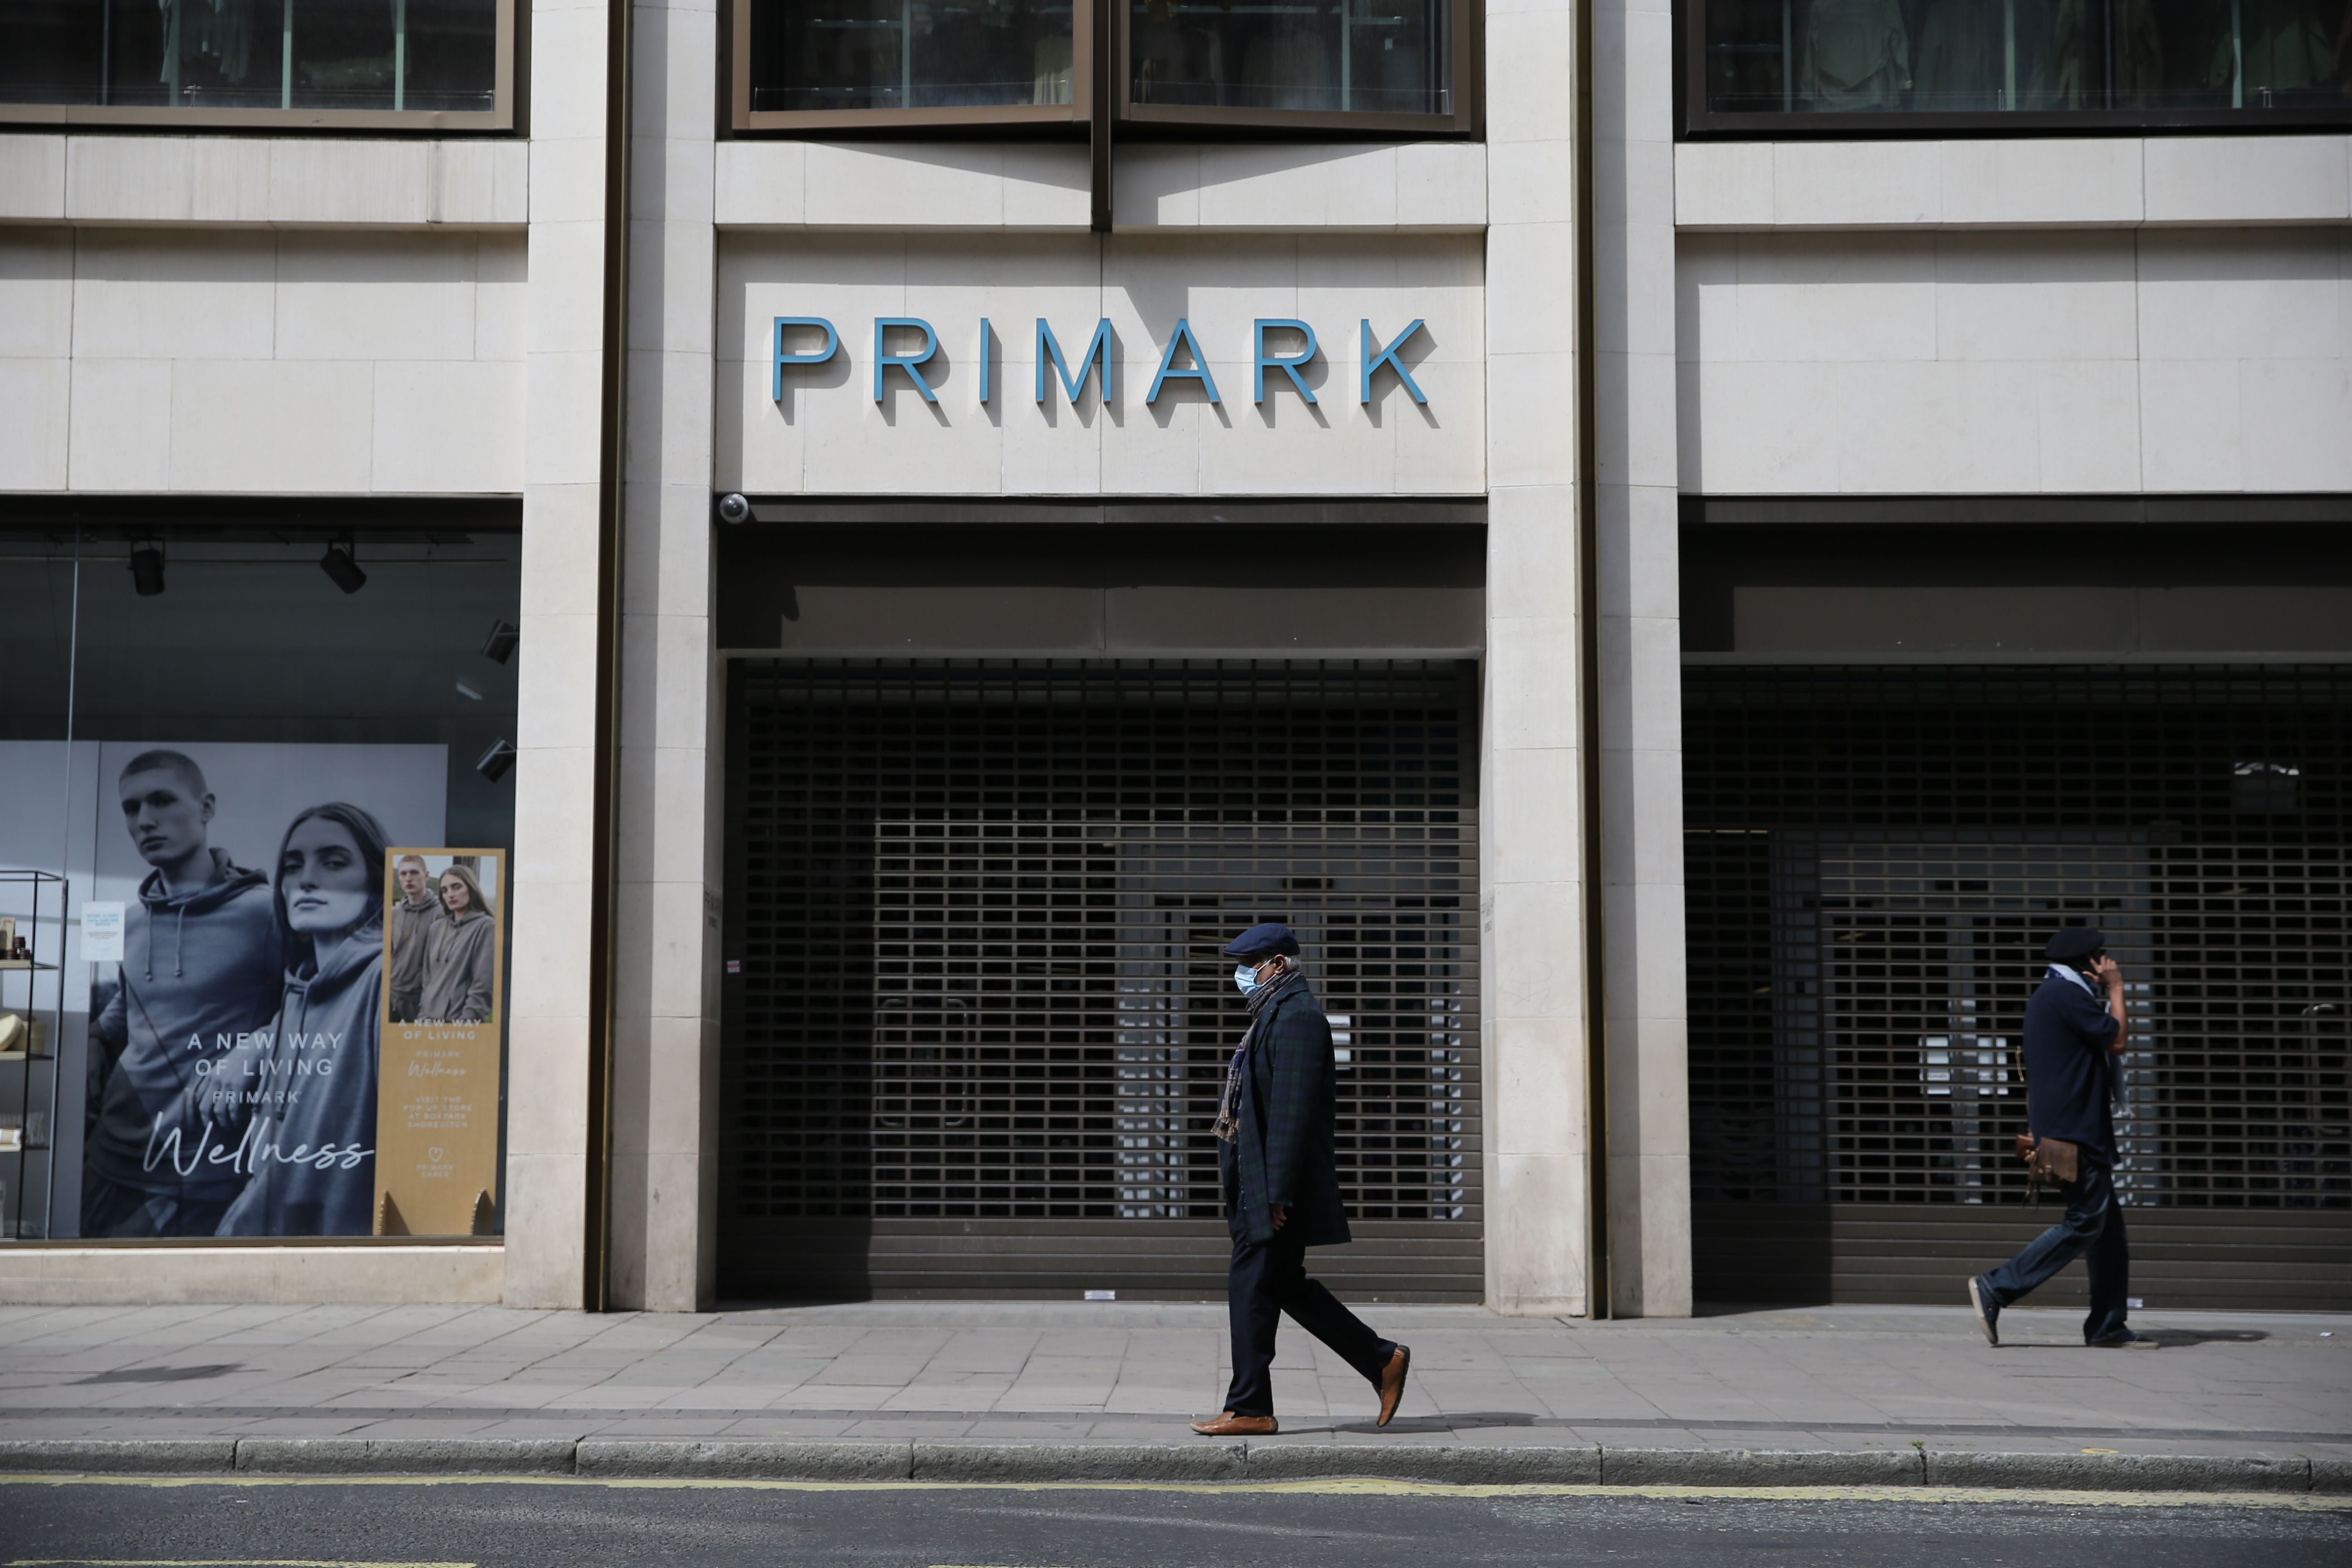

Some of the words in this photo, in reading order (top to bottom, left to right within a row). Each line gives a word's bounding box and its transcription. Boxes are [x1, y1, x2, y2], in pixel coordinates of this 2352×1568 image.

[772, 316, 1428, 405] PRIMARK
[398, 1018, 407, 1028] A
[414, 1018, 445, 1028] NEW
[451, 1018, 482, 1028] WAY
[187, 1033, 203, 1050] A
[216, 1033, 275, 1050] NEW
[288, 1033, 343, 1050] WAY
[403, 1030, 421, 1040] OF
[428, 1030, 476, 1040] LIVING
[195, 1058, 229, 1077] OF
[243, 1058, 333, 1077] LIVING
[408, 1059, 468, 1078] Wellness
[212, 1091, 299, 1104] PRIMARK
[143, 1111, 375, 1176] Wellness
